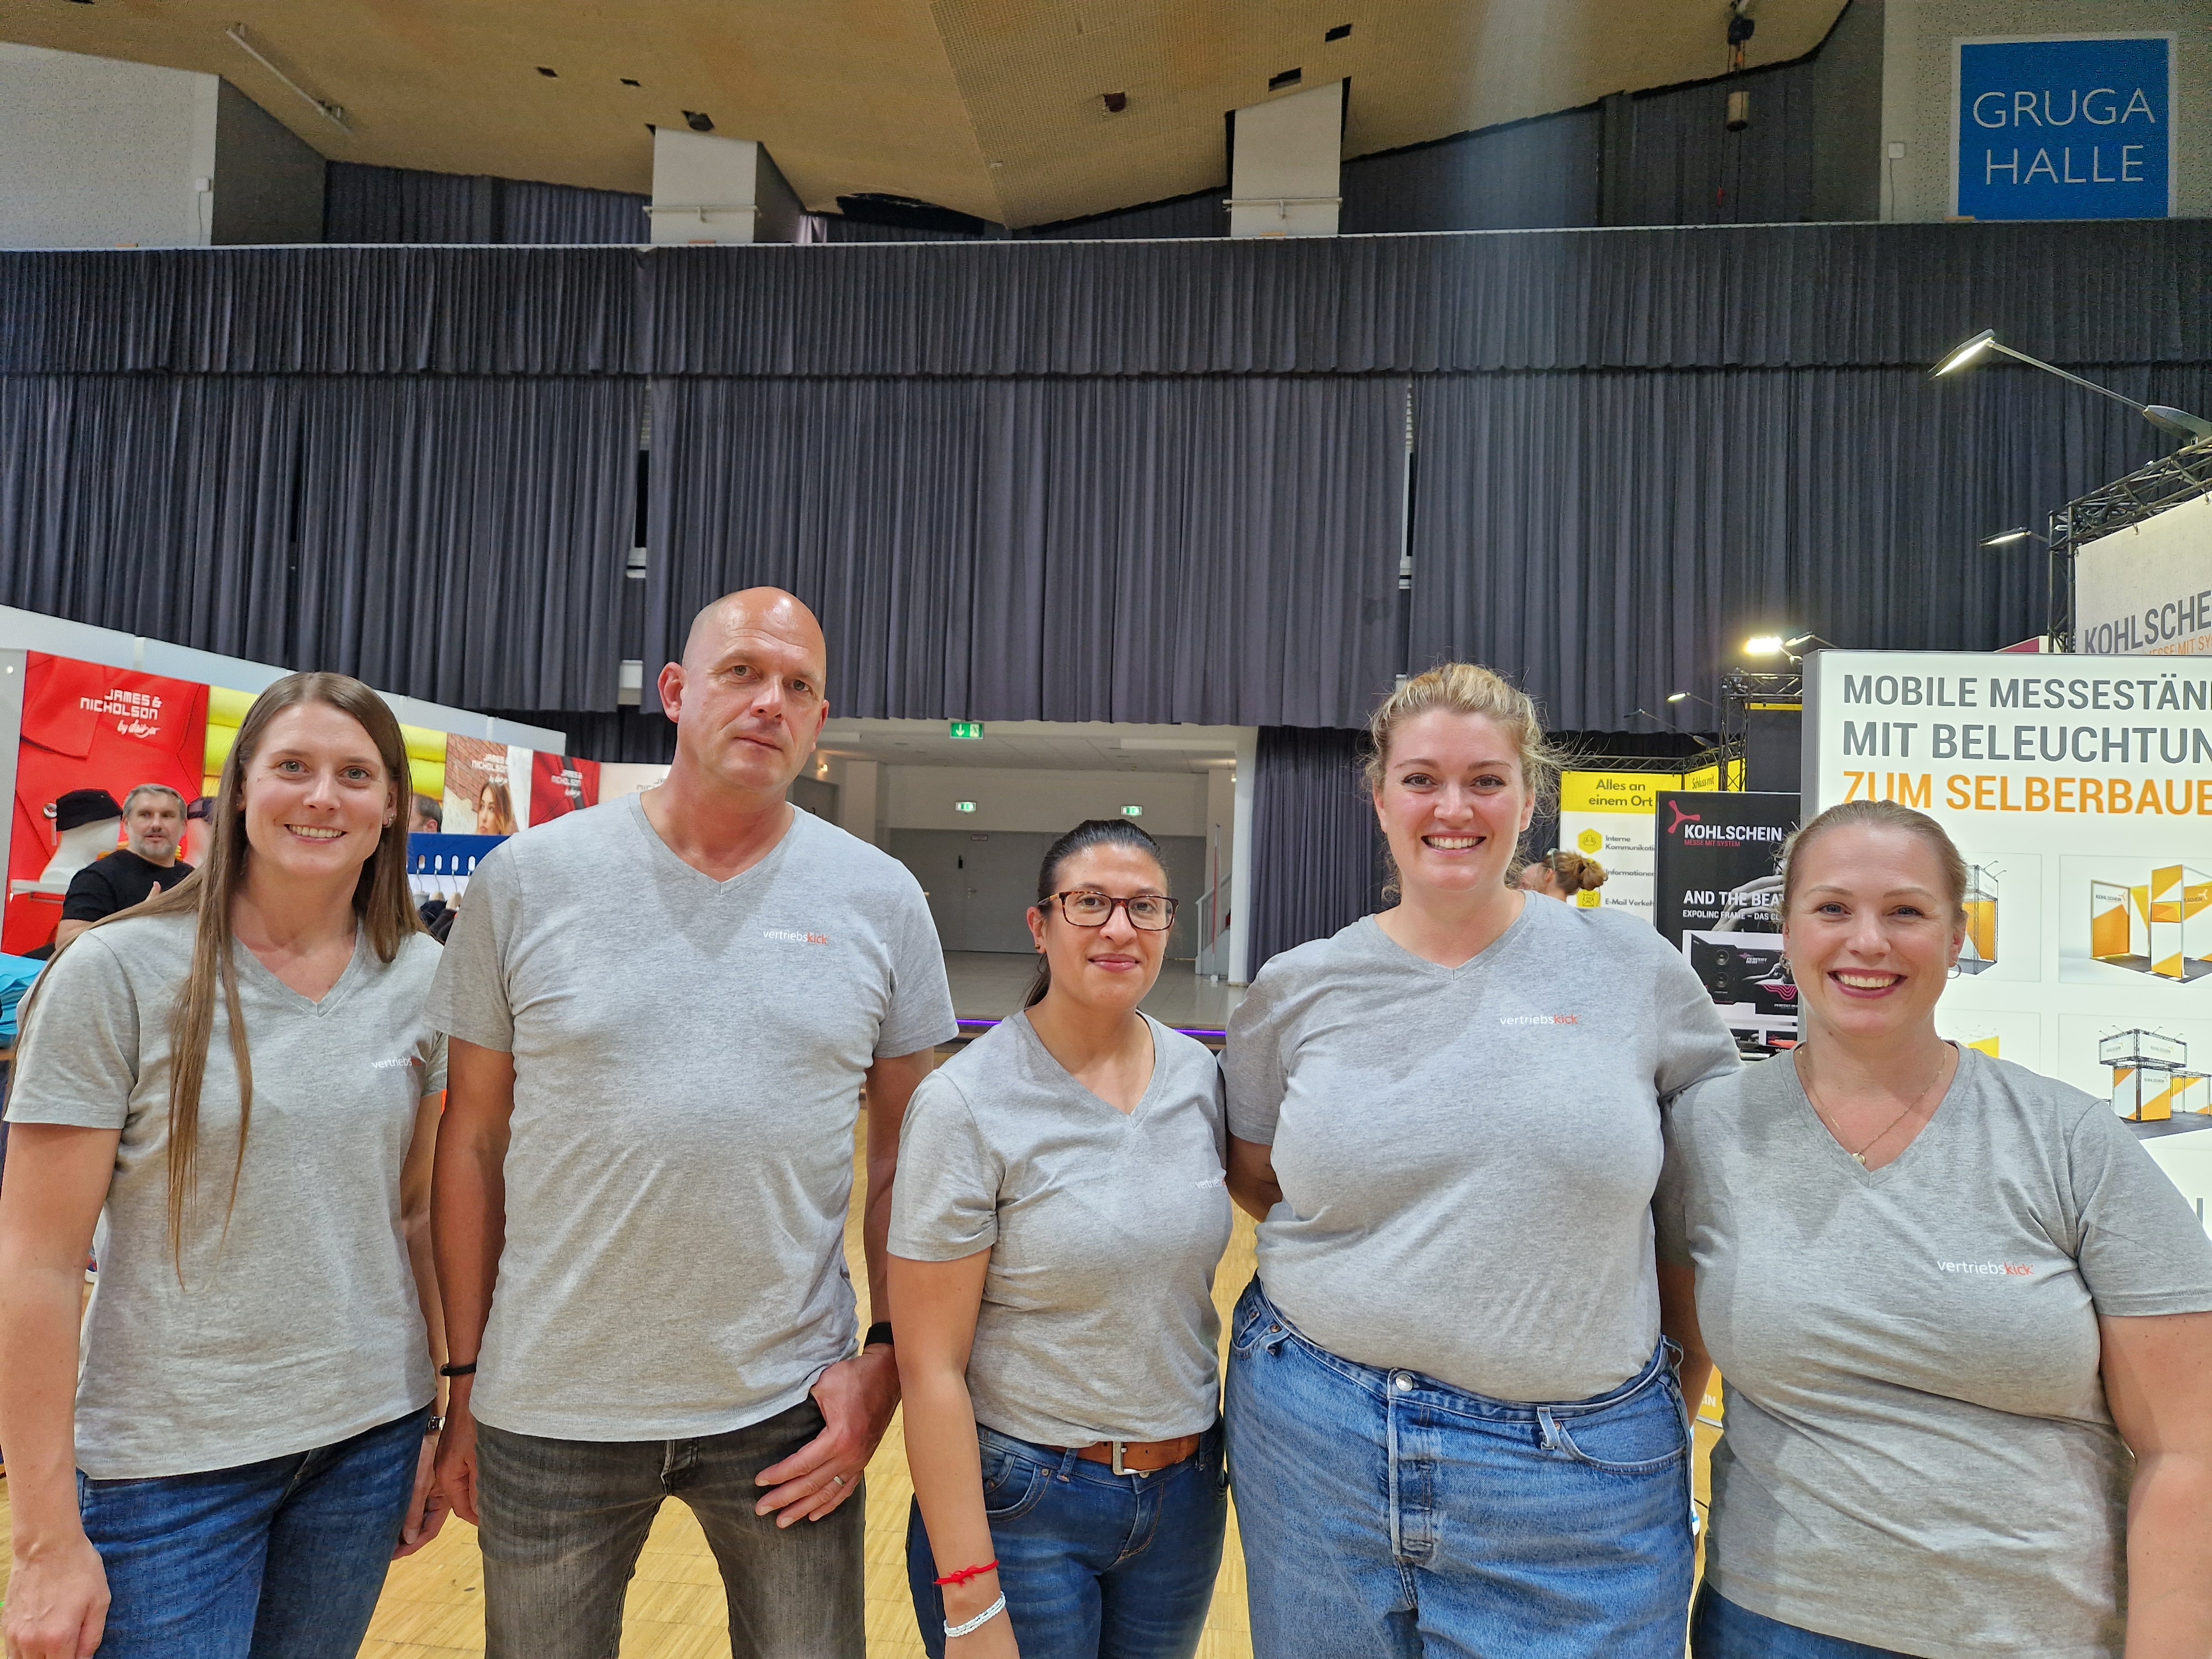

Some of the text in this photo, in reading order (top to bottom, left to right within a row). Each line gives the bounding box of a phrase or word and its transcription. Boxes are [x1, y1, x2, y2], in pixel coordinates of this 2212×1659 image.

[1973, 88, 2155, 128] GRUGA
[1986, 145, 2144, 185] HALLE
[2145, 644, 2174, 654] ESSE
[2178, 638, 2195, 654] MIT
[104, 688, 163, 708] JAMES &
[1844, 674, 2212, 710] MOBILE MESSESTÄN
[80, 697, 158, 720] NICHOLSON
[1843, 721, 1917, 758] MIT
[1595, 779, 1645, 791] Alles an
[1844, 771, 2212, 815] ZUM SELBERBAUE
[1588, 794, 1653, 807] einem Ort
[1684, 824, 1782, 841] KOHLSCHEIN
[1683, 890, 1714, 904] AND
[1719, 891, 1747, 906] THE
[1720, 911, 1745, 920] FRAME
[1754, 912, 1770, 921] DAS
[372, 1056, 422, 1070] vertriebs
